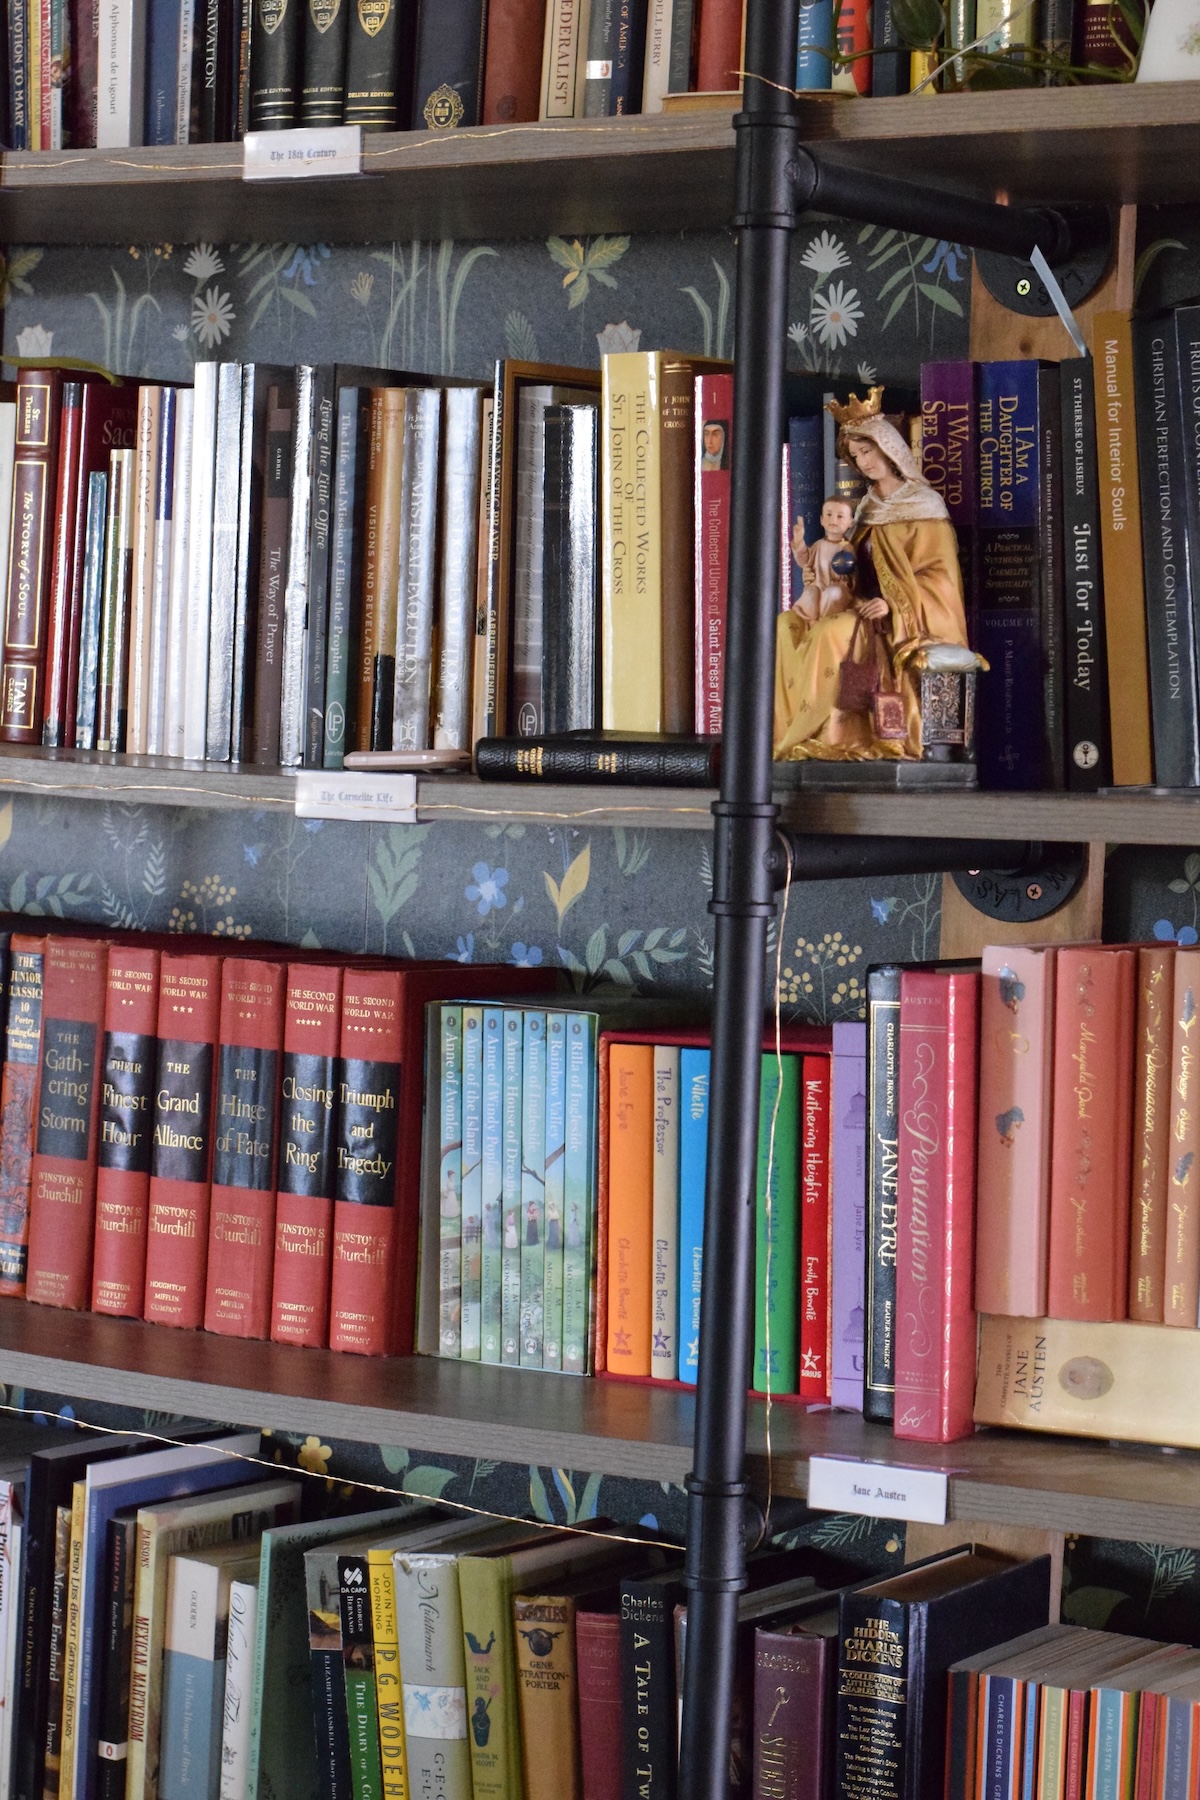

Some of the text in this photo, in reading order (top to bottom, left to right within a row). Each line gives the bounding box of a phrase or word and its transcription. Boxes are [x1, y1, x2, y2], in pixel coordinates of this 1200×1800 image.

[205, 0, 218, 88] SALVATION
[618, 5, 630, 69] OF AMERICA
[883, 10, 893, 44] SENDAK
[107, 4, 120, 115] Alphonsus de Ligouri
[652, 28, 663, 67] BERRY
[14, 68, 24, 86] TO
[41, 20, 51, 126] MARGARET MARY
[15, 91, 24, 126] MARY
[269, 148, 337, 162] The 18th Century
[947, 402, 969, 505] I WANT TO
[980, 399, 1000, 509] THE CHURCH
[999, 395, 1019, 512] DAUGHTER OF
[1073, 377, 1085, 496] ST. THERESE OF LISIEUX
[1104, 340, 1127, 531] Manual for Interior Souls
[1015, 424, 1035, 486] I AM A
[313, 398, 333, 551] Living the Little Office
[625, 482, 635, 503] OF
[635, 391, 650, 595] THE COLLECTED WORKS
[610, 393, 627, 595] ST. JOHN OF THE CROSS
[1152, 338, 1181, 699] CHRISTIAN PERFECTION AND CONTEMPLATION
[330, 412, 352, 675] The Life and Mission of Elias the Prophet
[264, 547, 282, 665] The Way of Prayer
[362, 505, 377, 684] VISIONS AND REVELATIONS
[1073, 522, 1095, 691] Just for Today
[707, 498, 723, 734] The Collected Works of Saint Teresa of Avila
[13, 677, 28, 715] TAN
[320, 790, 393, 802] The Carmelite Life
[11, 970, 42, 983] JUNIOR
[179, 976, 209, 987] SECOND
[302, 989, 336, 1002] SECOND
[45, 1049, 91, 1074] Gath-
[110, 1059, 142, 1074] THEIR
[167, 1061, 191, 1075] THE
[234, 1068, 258, 1082] THE
[47, 1077, 89, 1107] ering
[102, 1083, 149, 1111] Finest
[156, 1089, 200, 1114] Grand
[281, 1076, 335, 1110] Closing
[339, 1082, 395, 1113] Triumph
[445, 1032, 460, 1141] Anne of Avonlea
[549, 1039, 563, 1141] Rainbow Valley
[690, 1074, 709, 1120] Villette
[41, 1106, 86, 1134] Storm
[221, 1094, 267, 1125] Hinge
[291, 1113, 316, 1135] the
[654, 1067, 672, 1156] The Professor
[101, 1120, 143, 1148] Hour
[153, 1124, 204, 1151] Alliance
[215, 1128, 270, 1158] of Fate
[350, 1122, 375, 1139] and
[803, 1079, 823, 1205] Wuthering Heights
[286, 1142, 321, 1173] Ring
[336, 1146, 393, 1180] Tragedy
[877, 1134, 898, 1267] JANE EYRE
[655, 1238, 669, 1322] Charlotte Brontë
[804, 1256, 820, 1321] Emily Brontë
[1014, 1350, 1029, 1397] JANE
[1029, 1336, 1047, 1412] AUSTEN
[852, 1484, 907, 1502] Jane Austen
[141, 1529, 151, 1569] PARSONS
[189, 1590, 198, 1629] GODDEN
[372, 1577, 383, 1630] MORNING
[383, 1573, 394, 1635] JOY IN THE
[621, 1593, 664, 1609] Charles
[621, 1607, 665, 1623] Dickens
[49, 1571, 66, 1682] Merrie England
[853, 1626, 899, 1644] HIDDEN
[865, 1617, 890, 1631] THE
[529, 1660, 554, 1670] GENE
[844, 1638, 904, 1657] CHARLES
[846, 1649, 903, 1668] DICKENS
[130, 1615, 150, 1743] MEXICAN MARTYRDOM
[474, 1665, 491, 1674] JACK
[519, 1669, 571, 1681] STRATTON-
[525, 1680, 561, 1691] PORTER
[633, 1633, 652, 1753] A TALE OF
[994, 1694, 1005, 1778] CHARLES DICKENS
[1104, 1707, 1114, 1771] JANE AUSTEN
